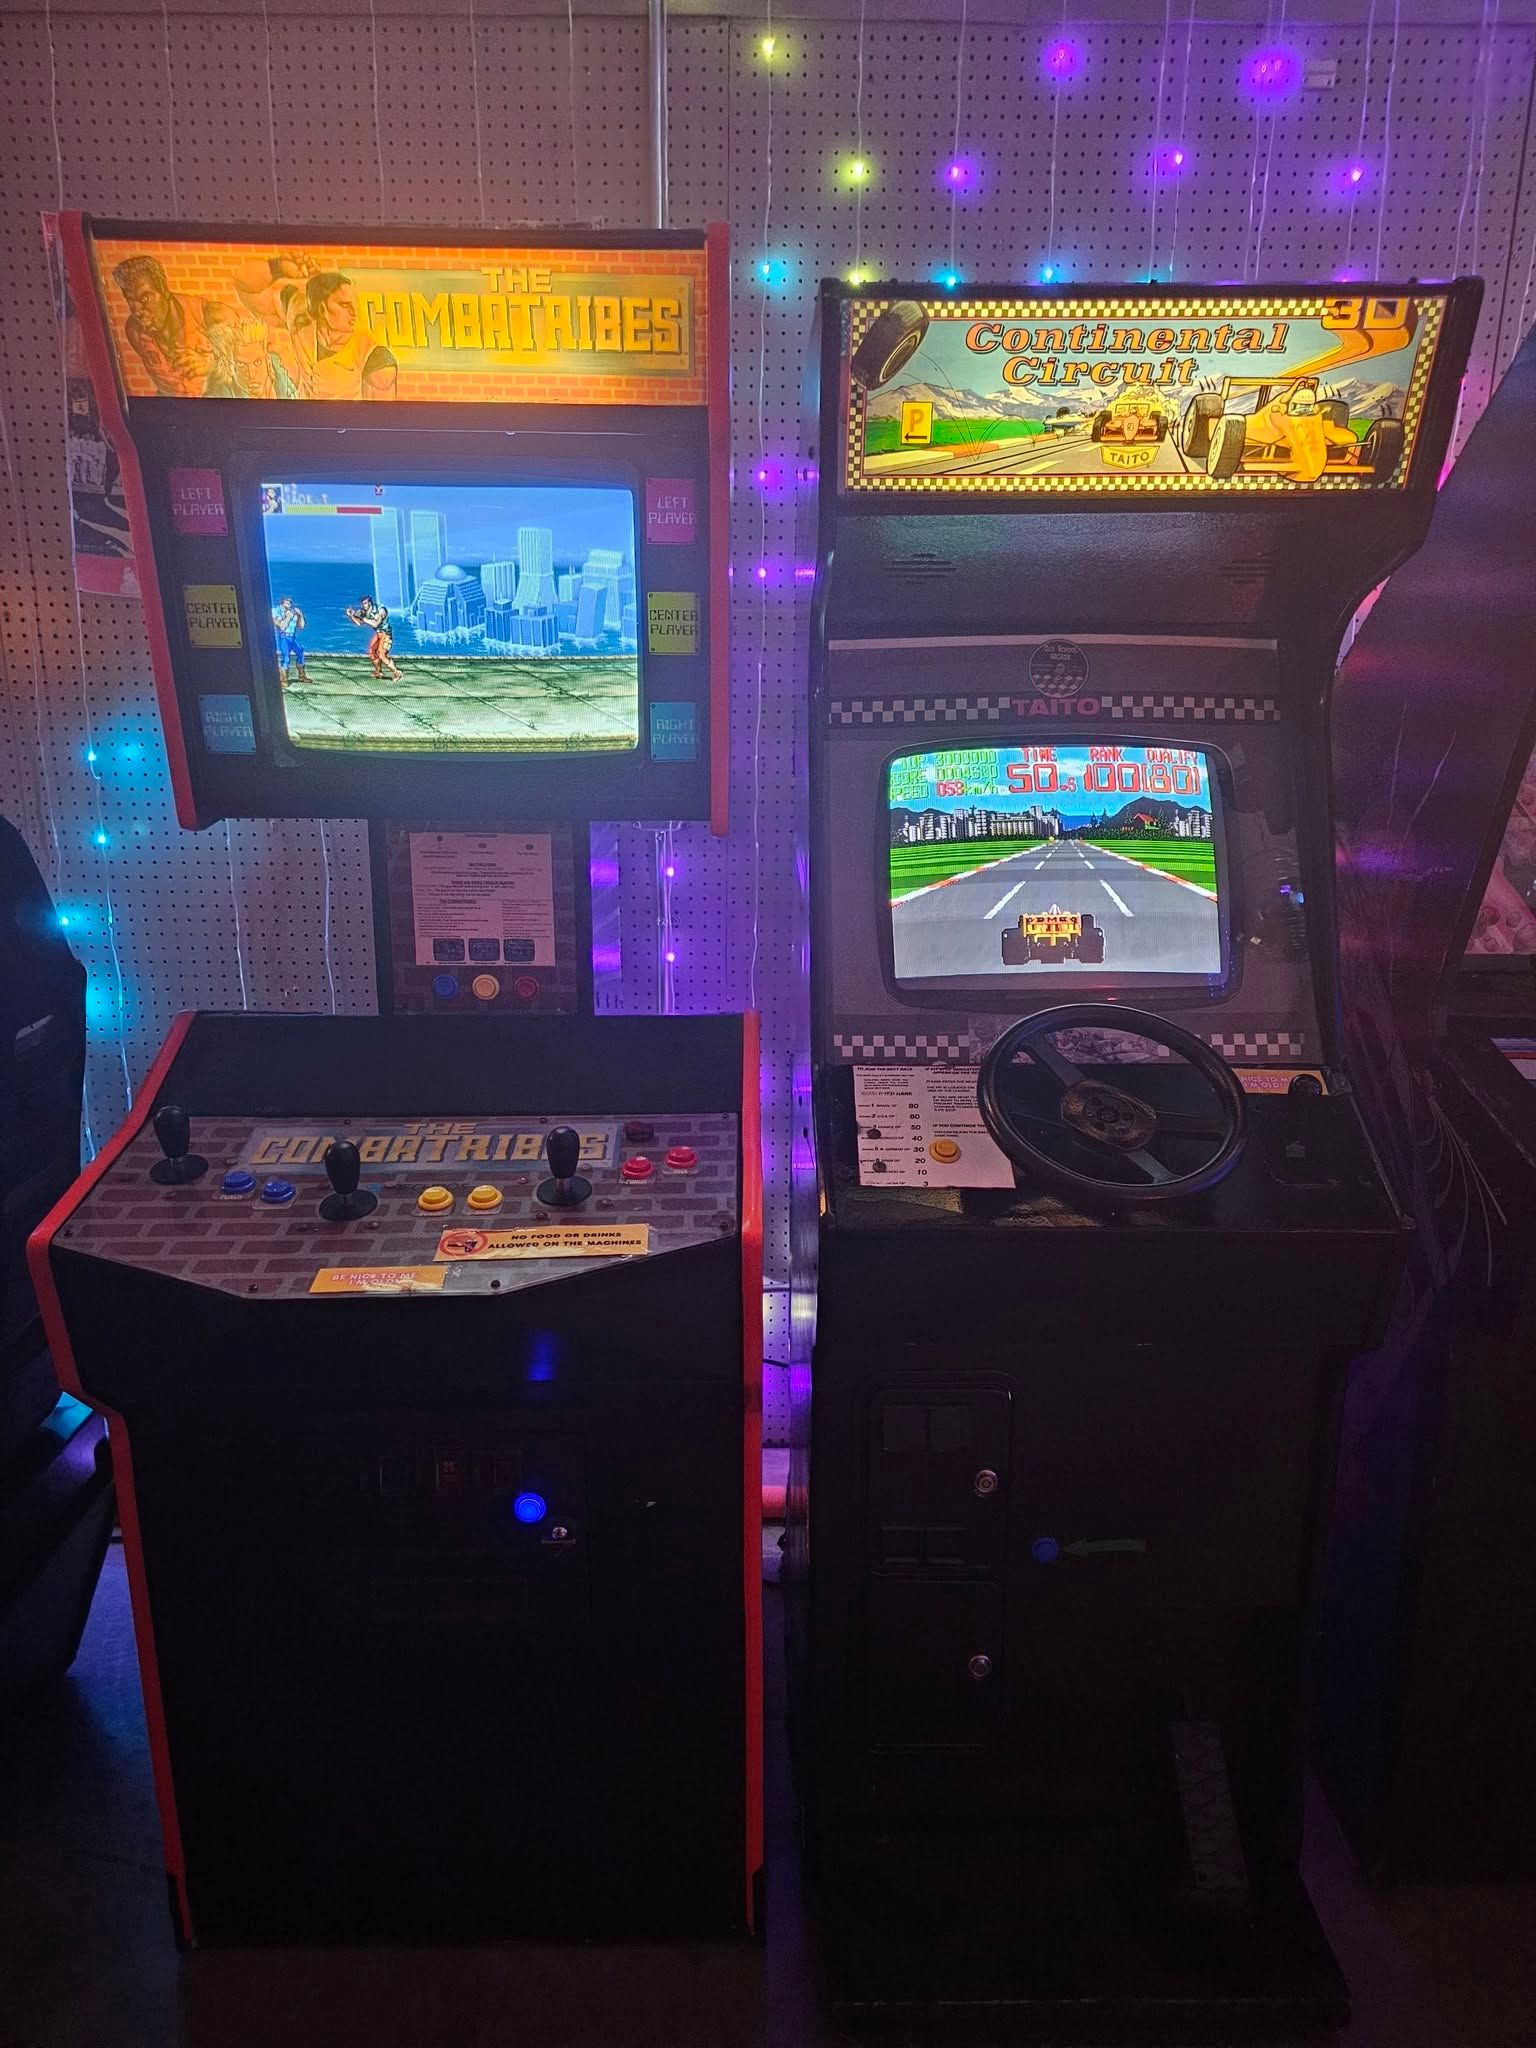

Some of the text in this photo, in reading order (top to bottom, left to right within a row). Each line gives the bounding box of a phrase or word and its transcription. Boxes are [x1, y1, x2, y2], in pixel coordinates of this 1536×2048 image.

[480, 266, 553, 294] THE
[363, 292, 684, 355] COMBATRIBES
[965, 321, 1289, 354] Continental
[1003, 355, 1198, 387] Circuit
[910, 407, 924, 432] P
[1110, 451, 1149, 465] TAITO
[180, 487, 212, 501] LEFT
[656, 496, 688, 509] LEFT
[172, 503, 225, 517] PLAYER
[648, 512, 697, 525] PLAYER
[186, 602, 237, 616] CENTER
[649, 609, 698, 622] CENTER
[188, 616, 239, 631] PLAYER
[650, 624, 698, 637] PLAYER
[1010, 697, 1101, 717] TAITO
[205, 711, 246, 724] RIGHT
[204, 725, 254, 739] PLAYER
[655, 719, 695, 732] RIGHT
[652, 732, 698, 746] PLAYER
[1022, 747, 1198, 765] TIME RANK QUALIFY
[403, 1122, 480, 1136] THE
[250, 1134, 608, 1165] COBATRIBS
[511, 1233, 528, 1241] NO
[530, 1232, 561, 1240] FOOD
[583, 1231, 622, 1239] DRINKS
[487, 1241, 540, 1250] ALLOWED
[562, 1240, 583, 1248] THE
[586, 1239, 642, 1248] MACHINES
